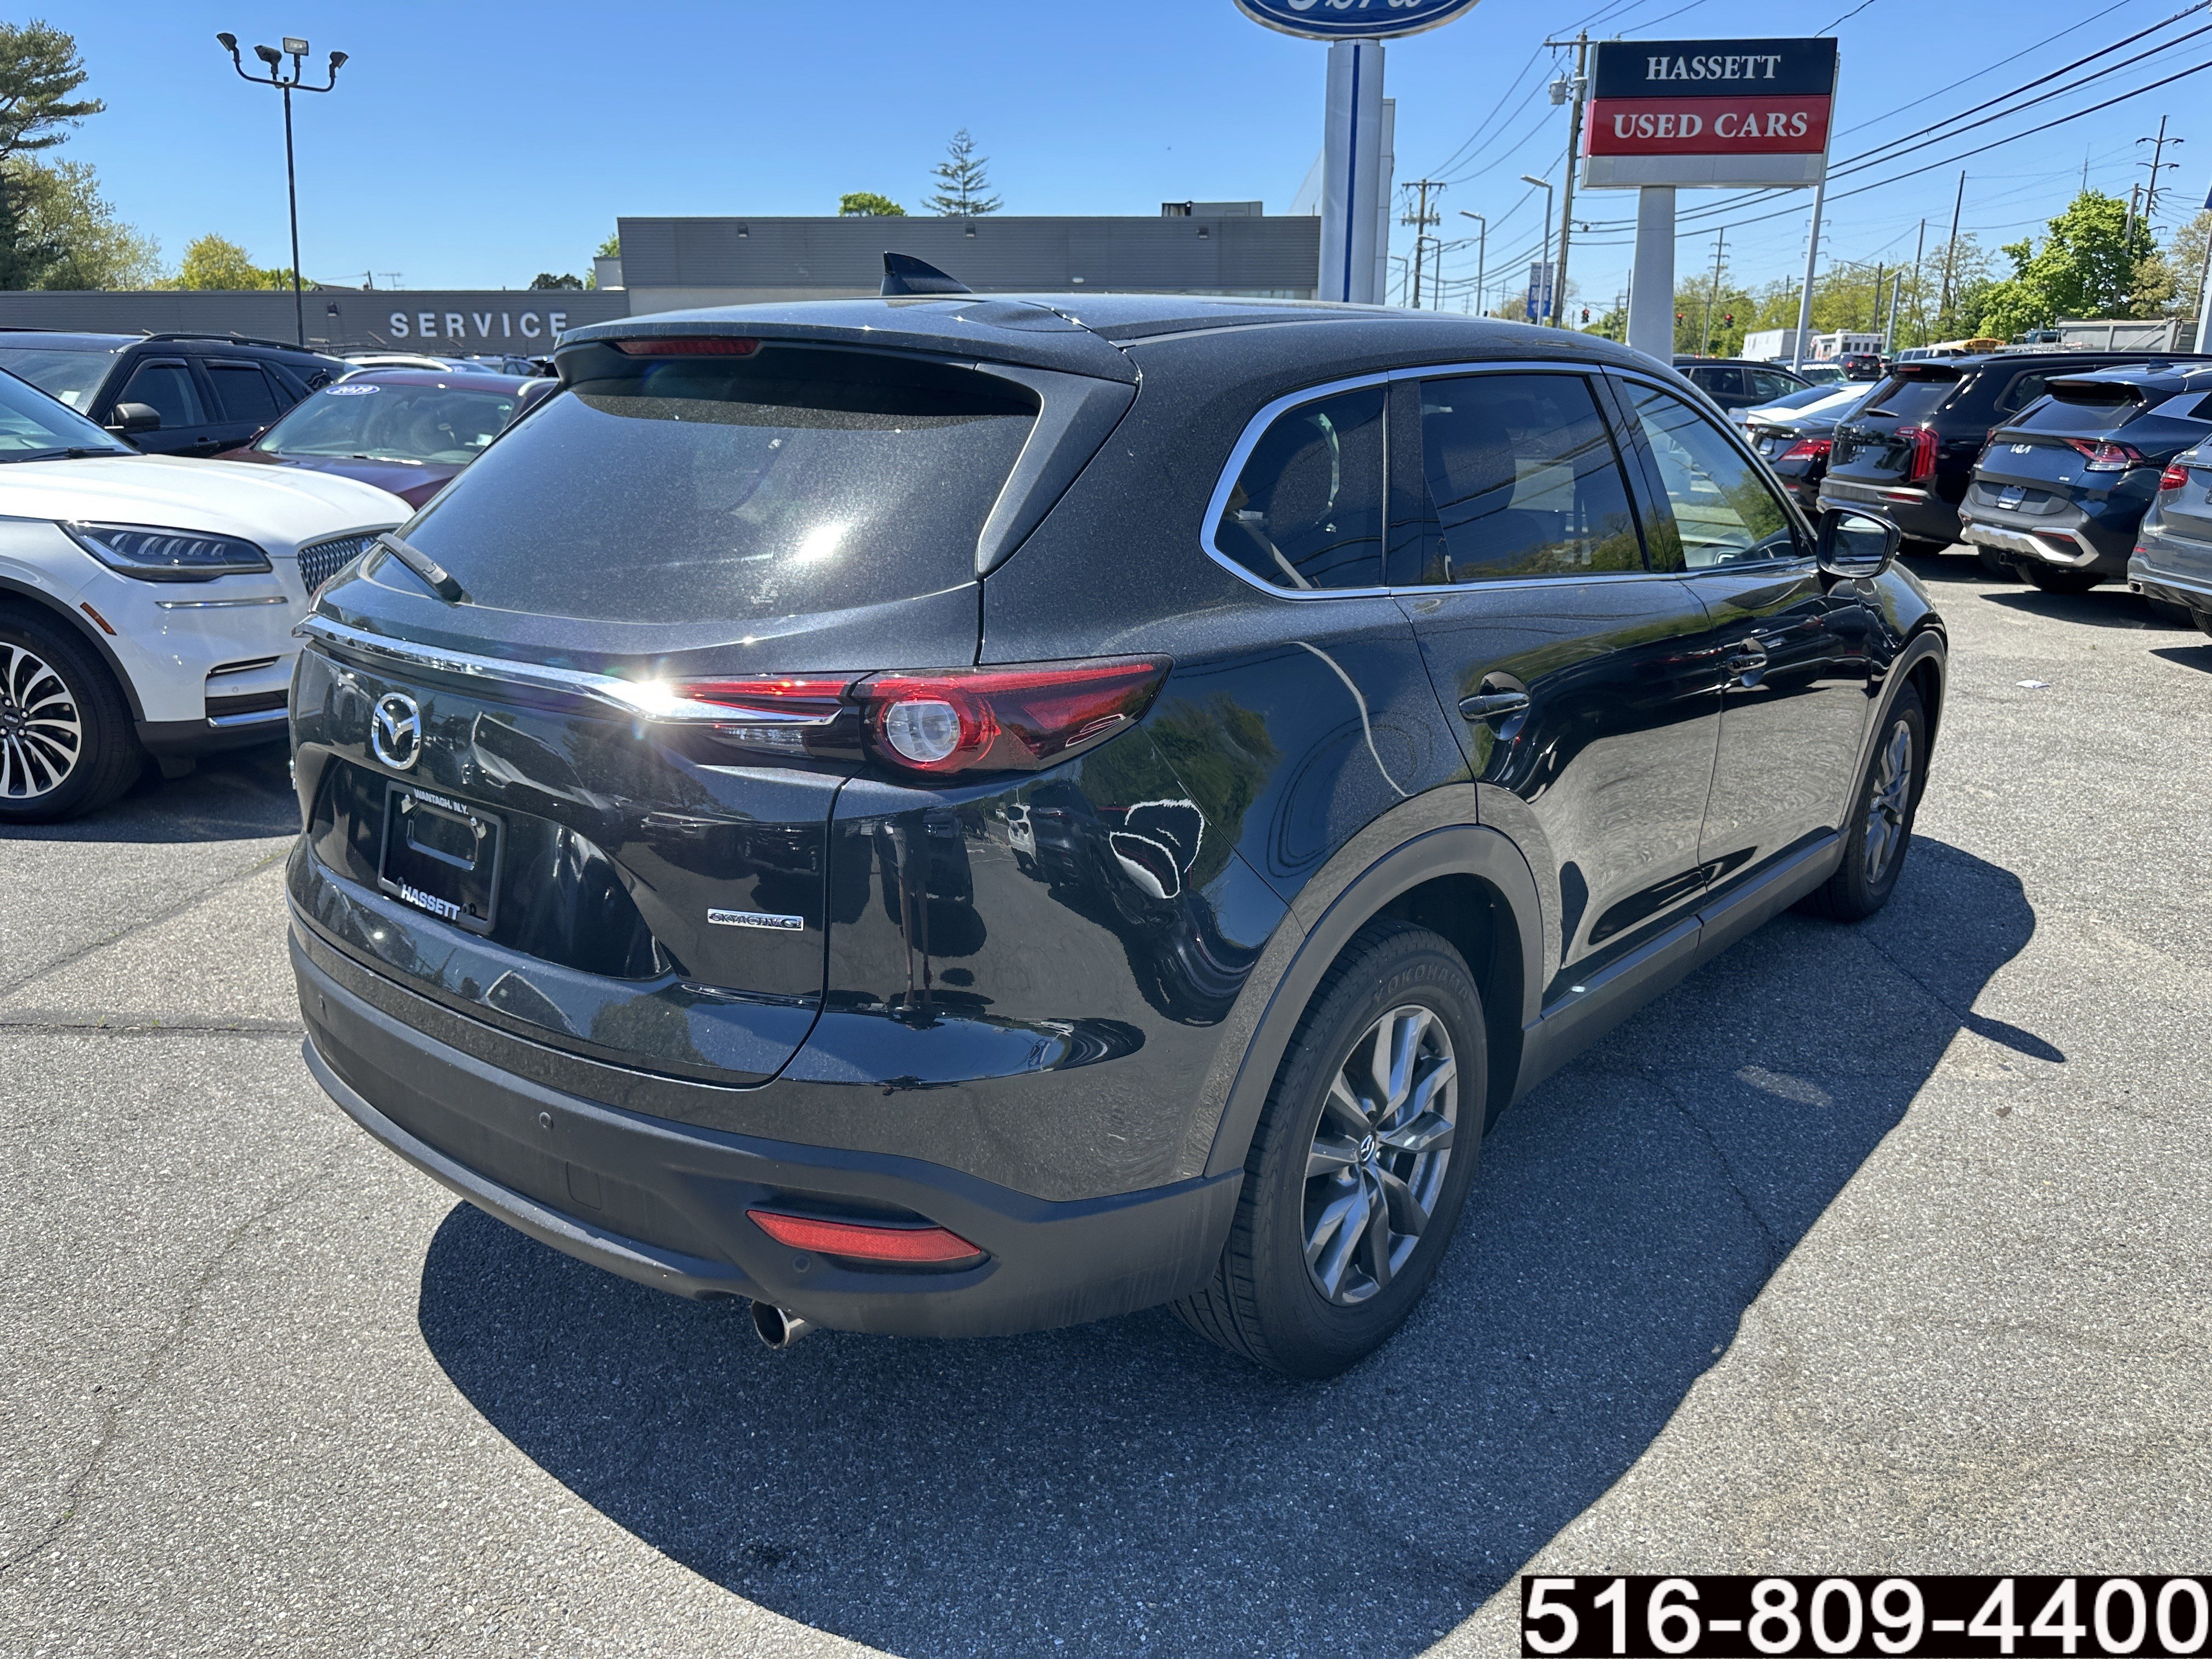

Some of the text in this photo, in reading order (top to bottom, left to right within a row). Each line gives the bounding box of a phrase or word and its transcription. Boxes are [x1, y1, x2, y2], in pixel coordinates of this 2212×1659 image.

[1646, 55, 1781, 80] HASSETT
[1613, 111, 1808, 138] USED CARS
[390, 312, 567, 338] SERVICE
[453, 801, 469, 815] N.Y.
[401, 884, 460, 921] HASSETT
[1374, 964, 1469, 1003] YOKOHAMA
